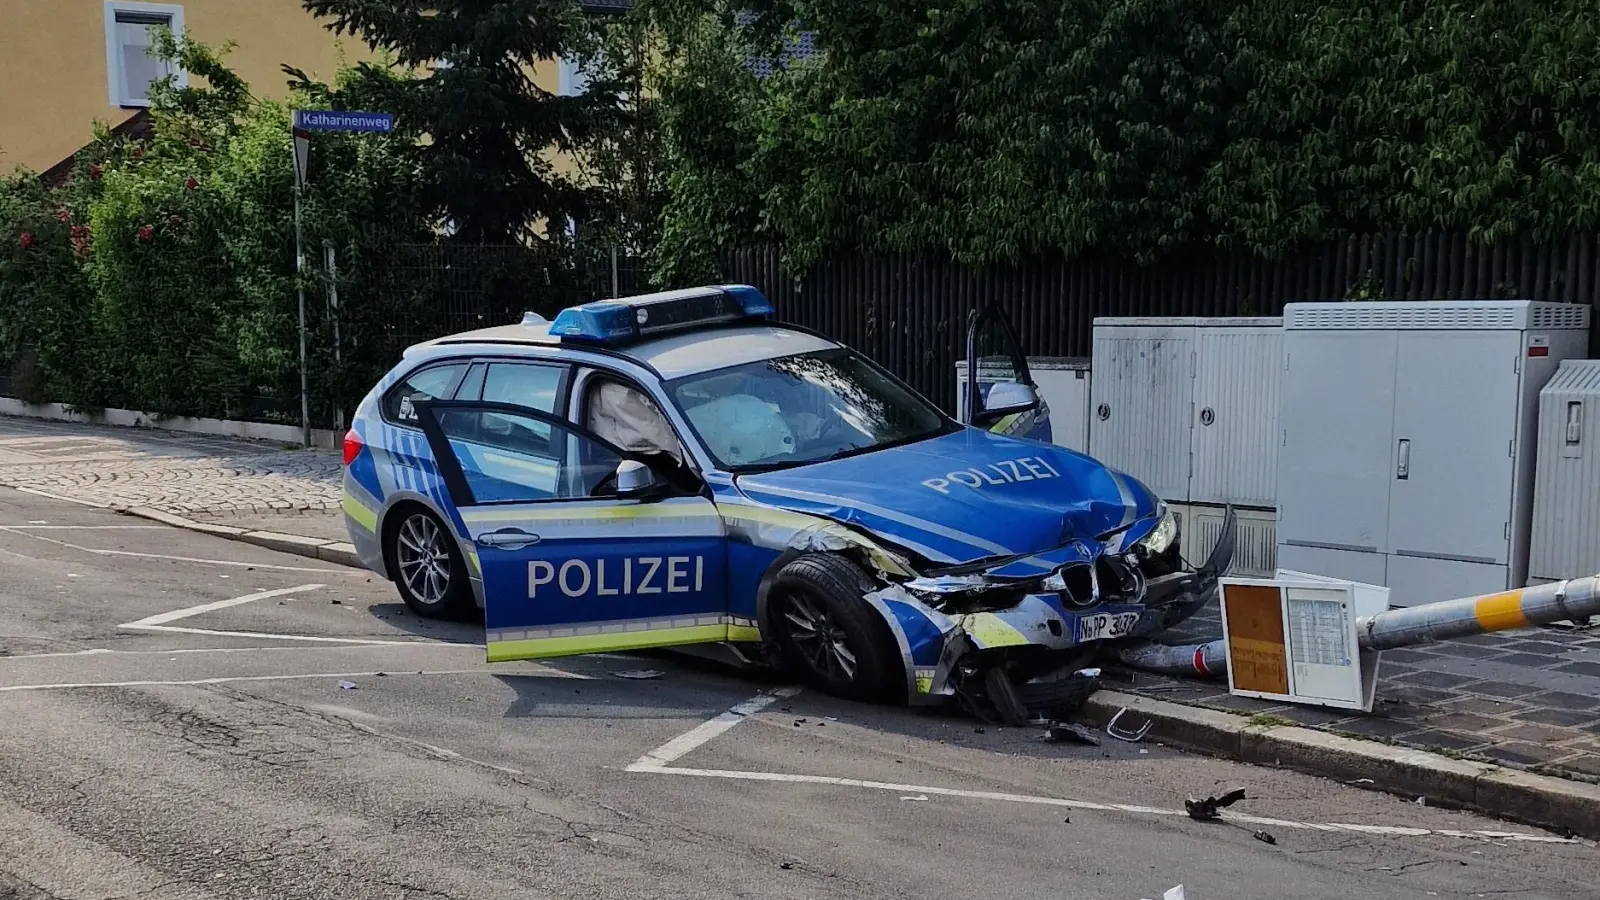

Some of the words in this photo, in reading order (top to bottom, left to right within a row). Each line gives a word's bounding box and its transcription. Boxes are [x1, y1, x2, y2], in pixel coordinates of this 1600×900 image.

[303, 113, 390, 130] Katharinenweg
[920, 456, 1061, 494] POLIZEI
[527, 556, 704, 598] POLIZEI
